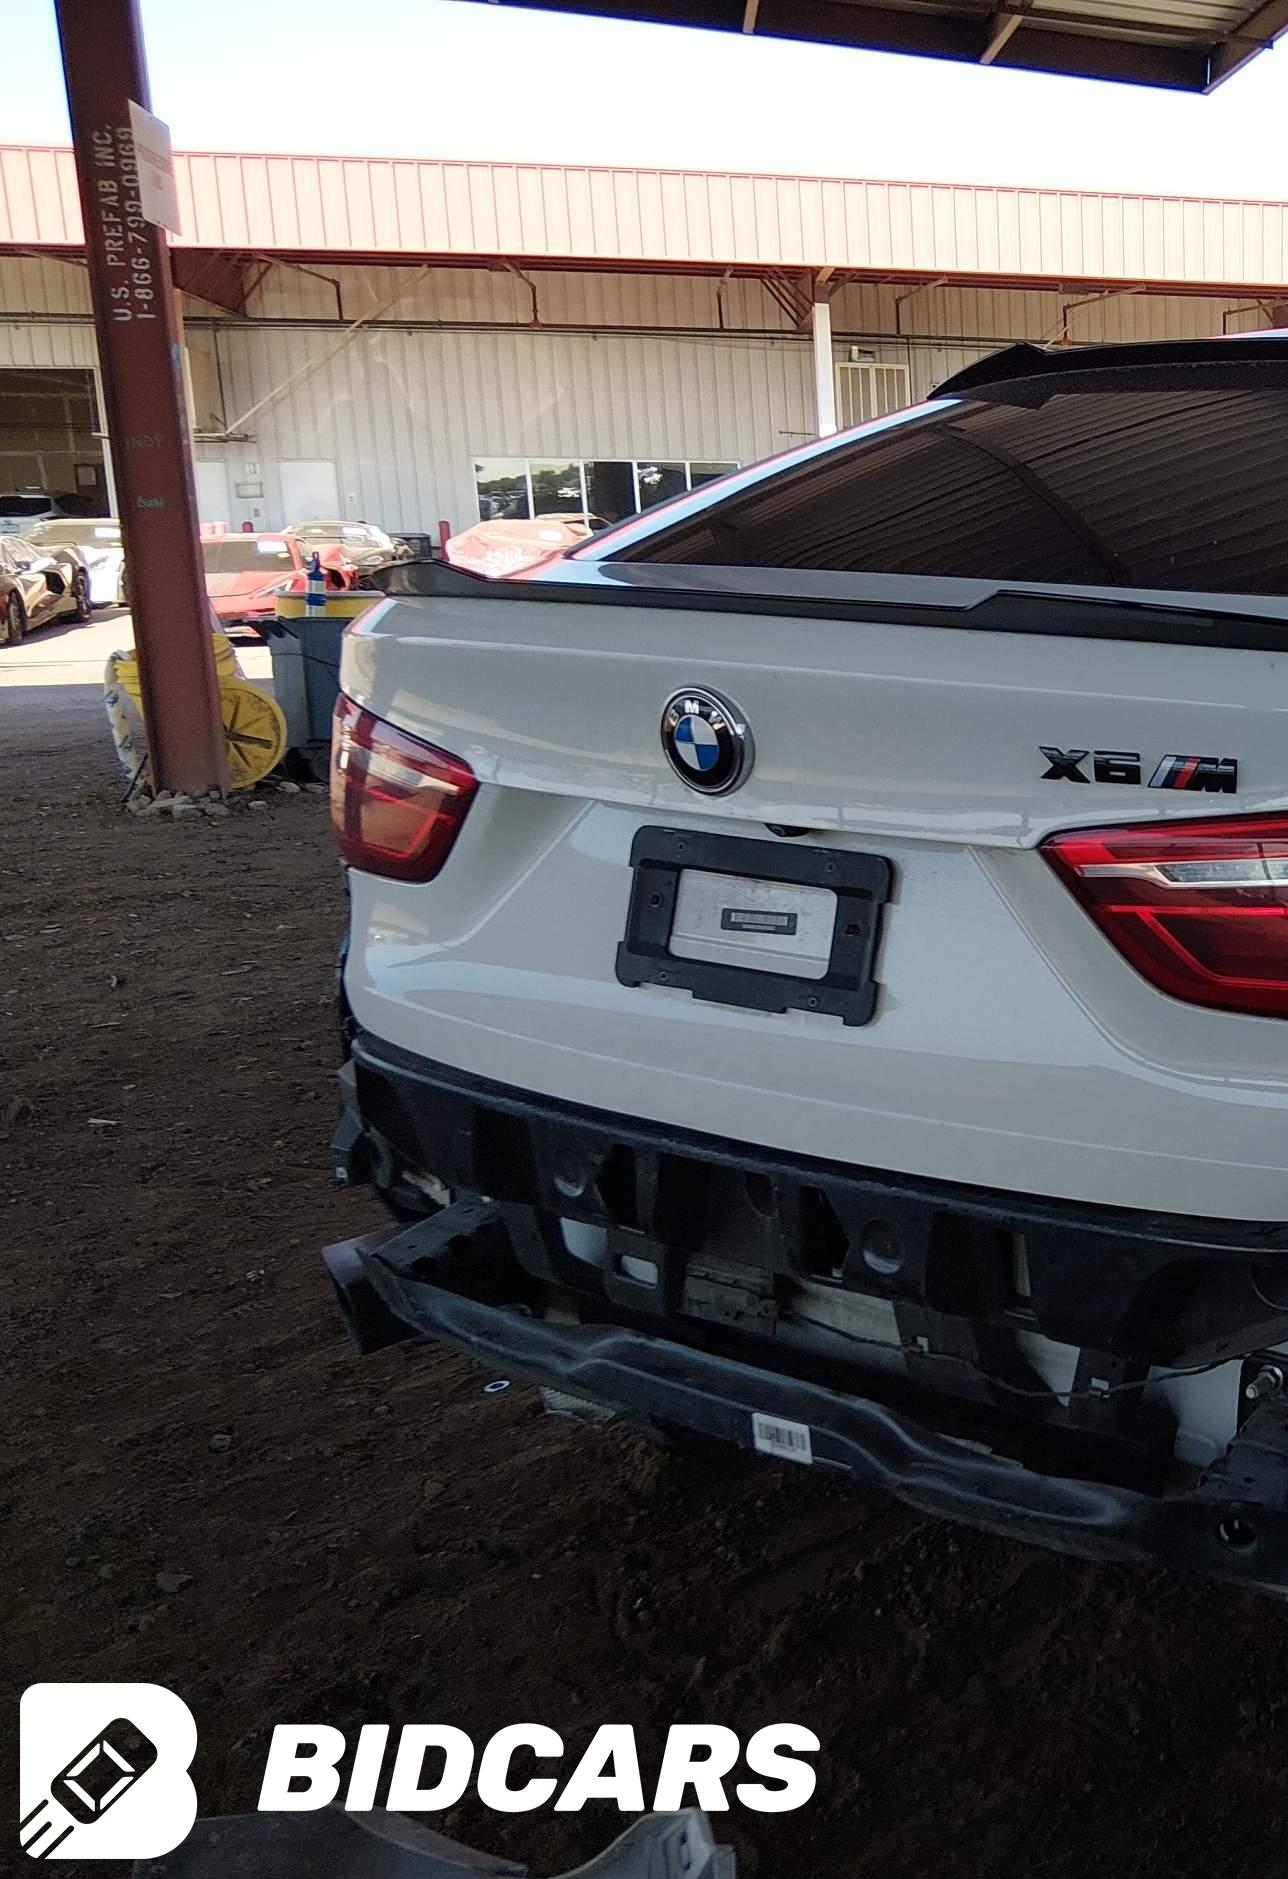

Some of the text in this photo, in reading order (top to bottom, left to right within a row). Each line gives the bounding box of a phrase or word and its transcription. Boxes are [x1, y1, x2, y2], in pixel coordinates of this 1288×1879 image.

[92, 125, 132, 322] U.S. PREFAB INC.
[667, 699, 726, 731] BMW
